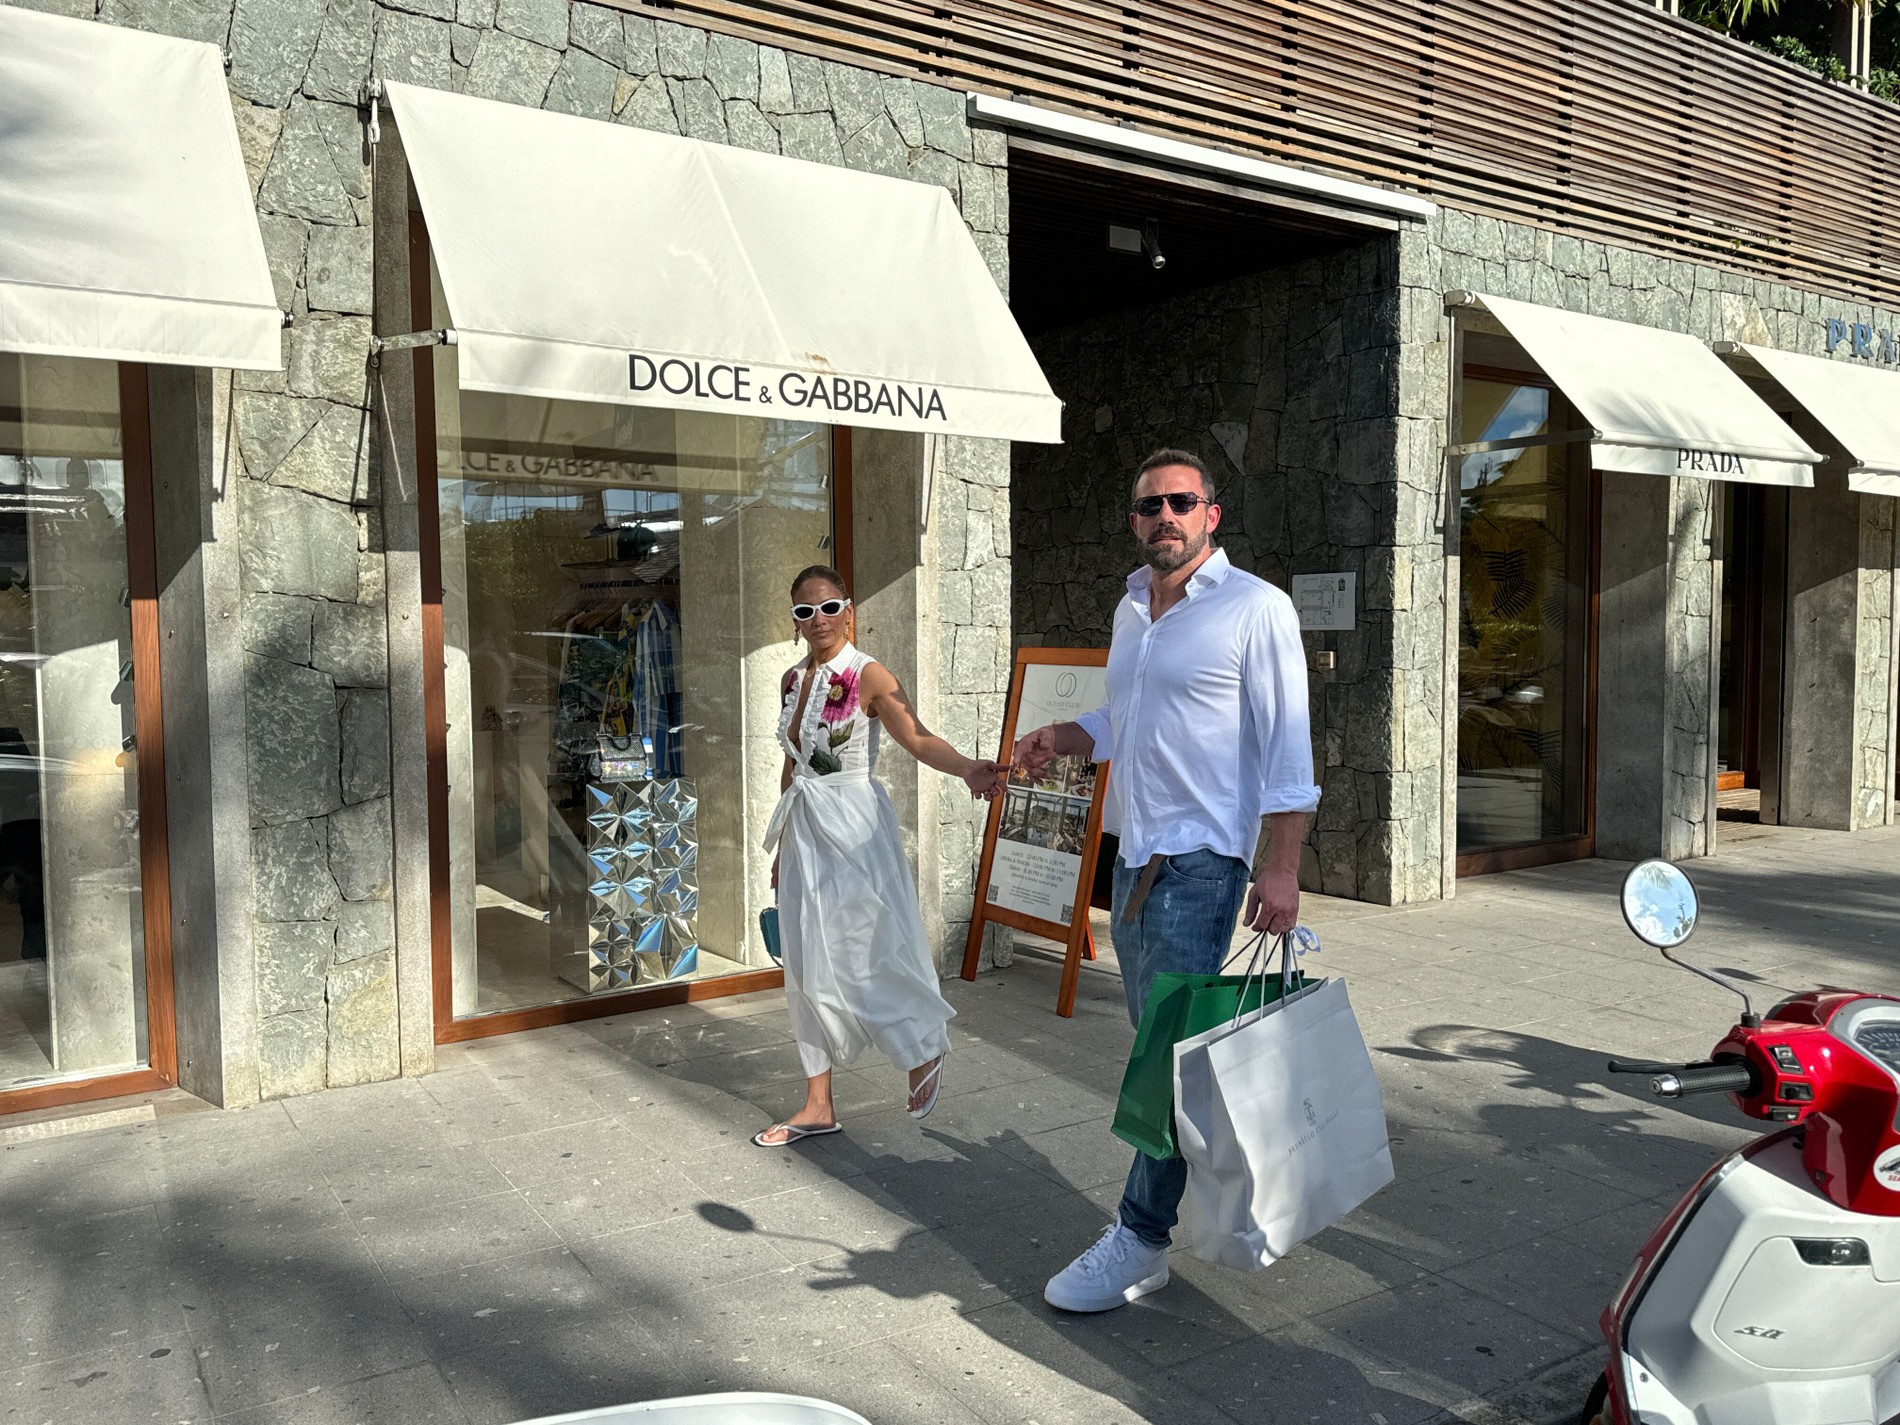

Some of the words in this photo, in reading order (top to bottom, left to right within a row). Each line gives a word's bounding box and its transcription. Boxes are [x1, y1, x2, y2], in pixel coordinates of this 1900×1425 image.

[1825, 317, 1900, 363] PRA
[629, 353, 751, 402] DOLCE
[759, 386, 773, 404] &
[778, 372, 947, 421] GABBANA
[521, 452, 661, 481] GABBANA
[1677, 448, 1745, 474] PRADA
